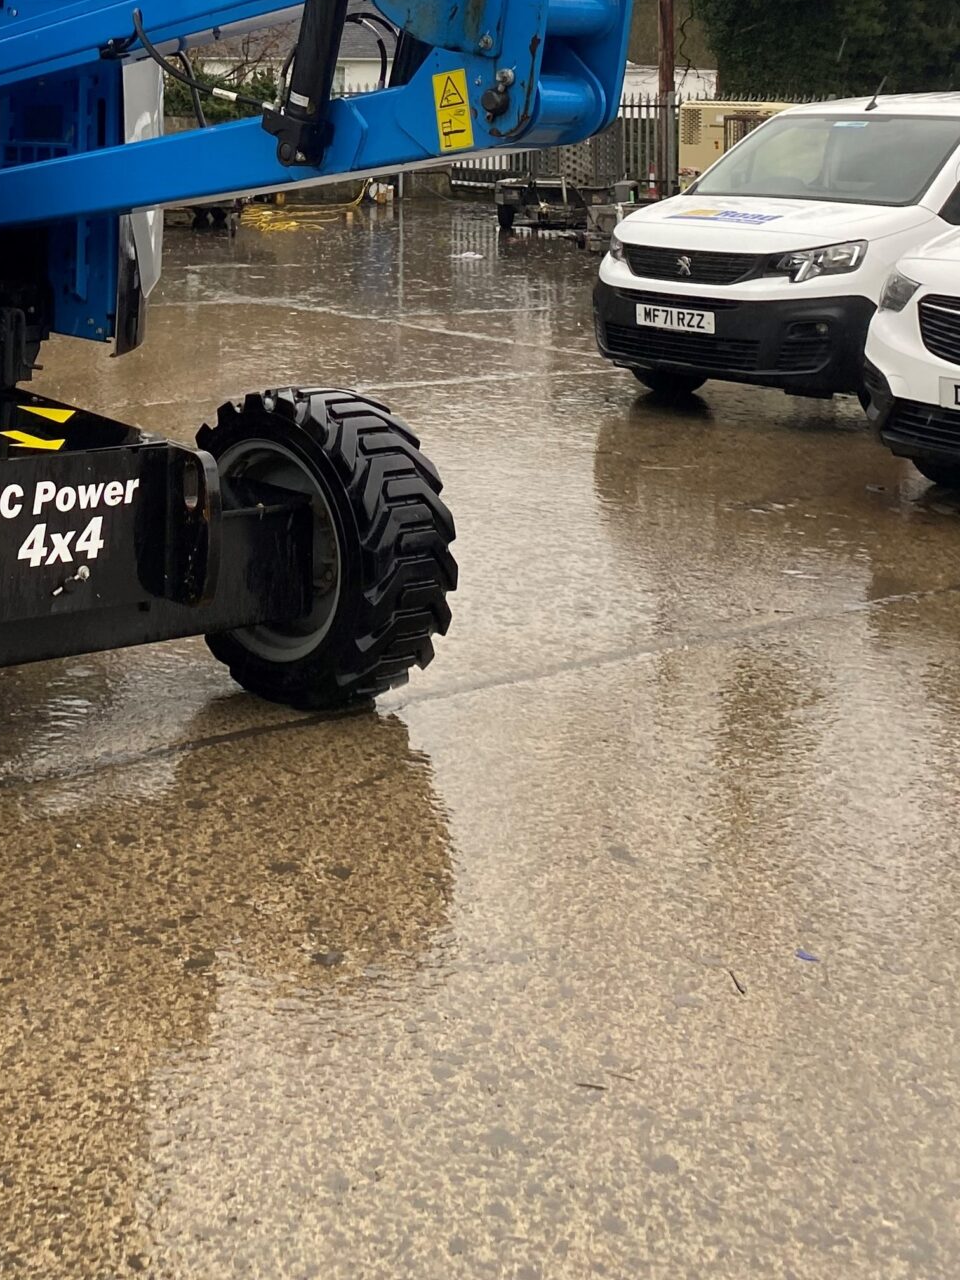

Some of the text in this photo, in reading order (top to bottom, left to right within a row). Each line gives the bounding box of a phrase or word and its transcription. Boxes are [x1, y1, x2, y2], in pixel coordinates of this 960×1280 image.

[644, 307, 705, 329] MF71 RZZ
[32, 478, 140, 516] Power
[17, 516, 105, 568] 4x4
